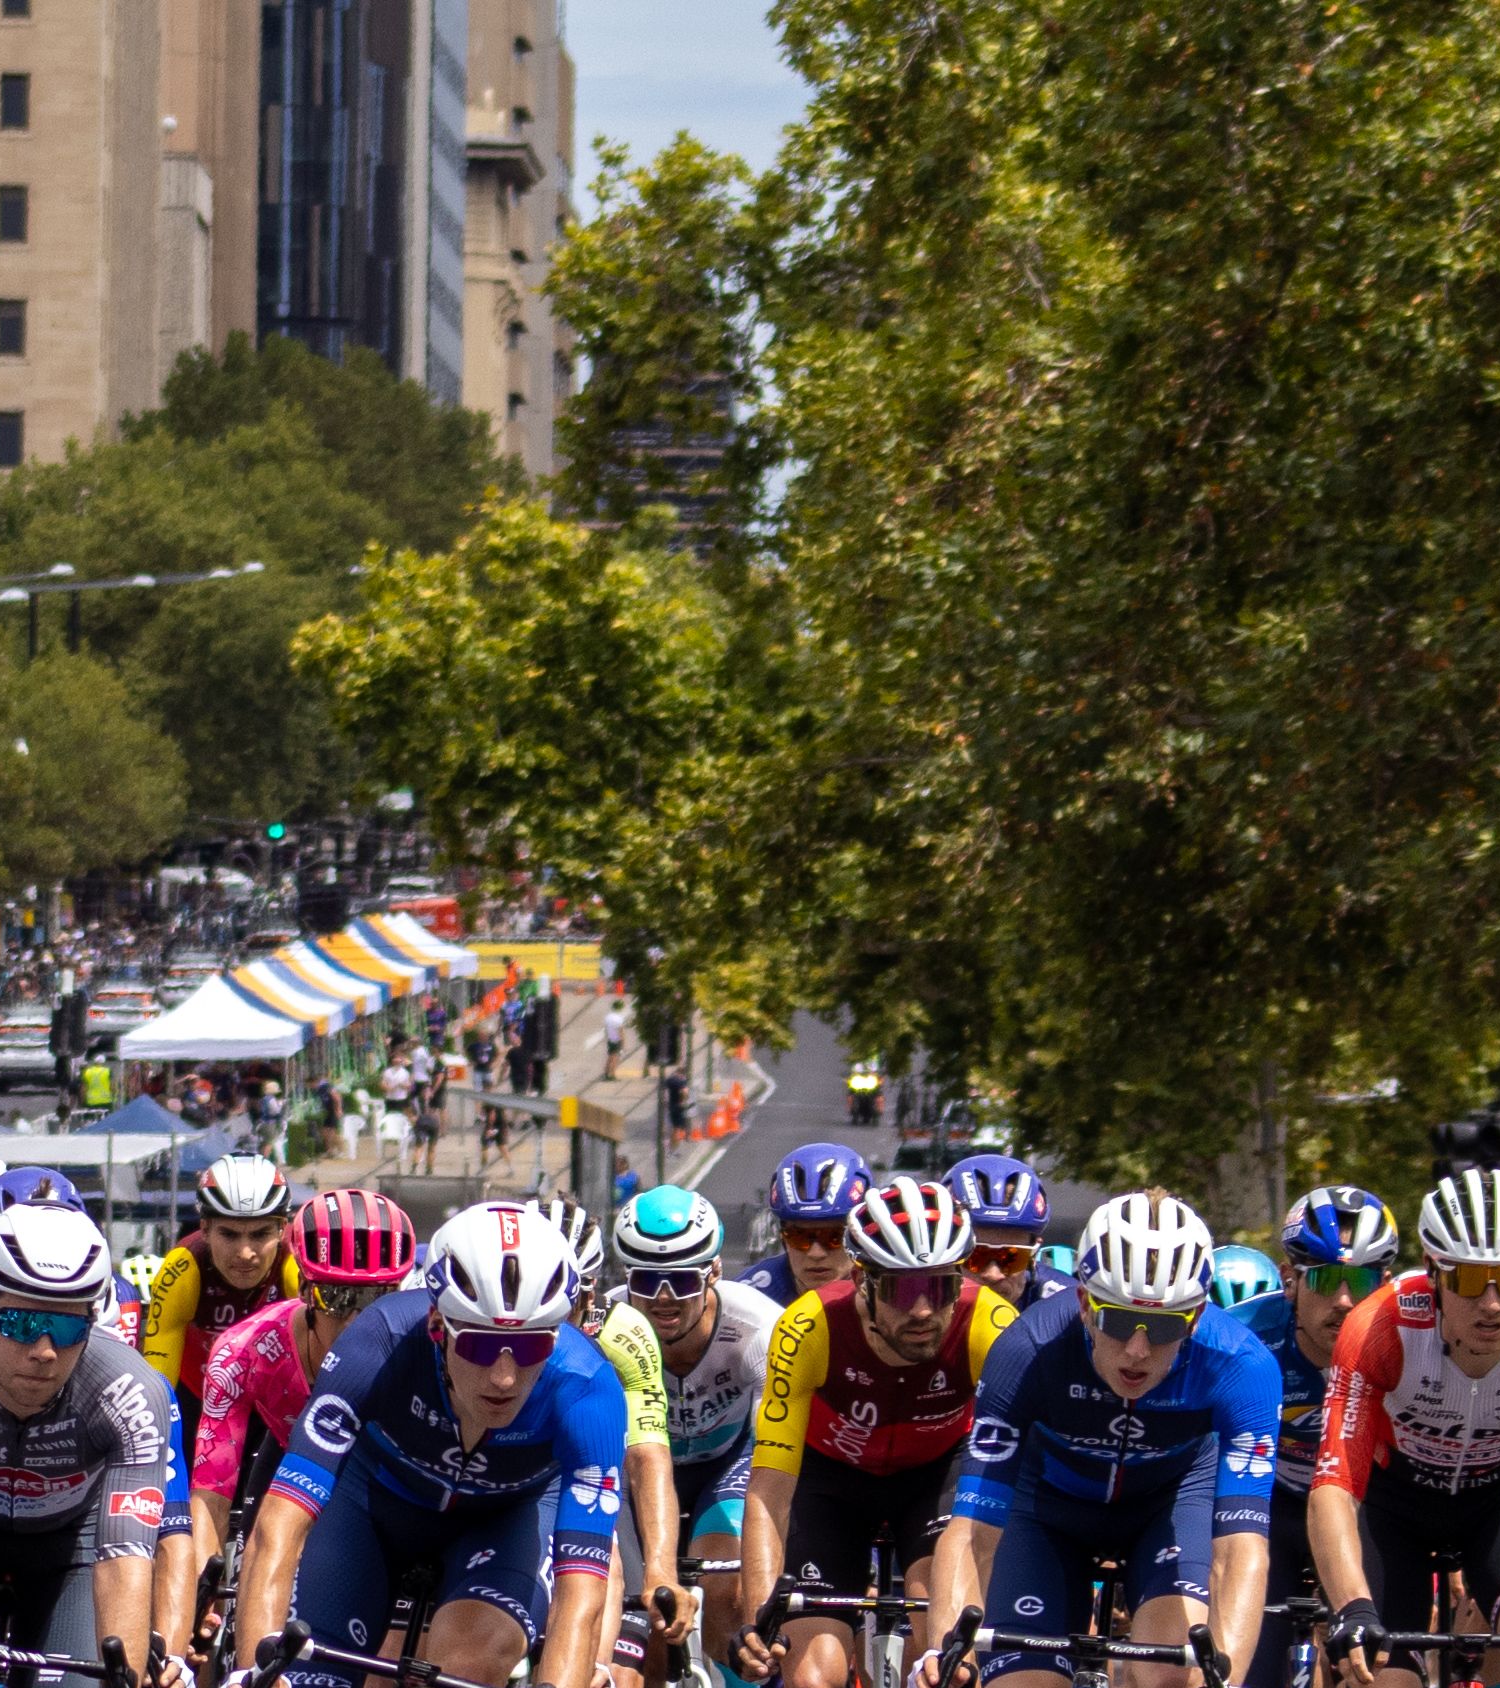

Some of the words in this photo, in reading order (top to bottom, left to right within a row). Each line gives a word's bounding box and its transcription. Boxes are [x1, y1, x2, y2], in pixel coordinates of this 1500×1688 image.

[783, 1167, 796, 1204] LAZER
[146, 1257, 189, 1338] Cofidis
[630, 1326, 658, 1373] SKODA
[764, 1313, 816, 1422] Cofidis
[104, 1373, 164, 1466] Alpecin
[1340, 1372, 1364, 1439] TECNORD
[1414, 1393, 1442, 1405] uvex
[26, 1440, 76, 1451] CANYON
[43, 1419, 76, 1434] ZWIFT
[1413, 1474, 1498, 1489] FANTINI
